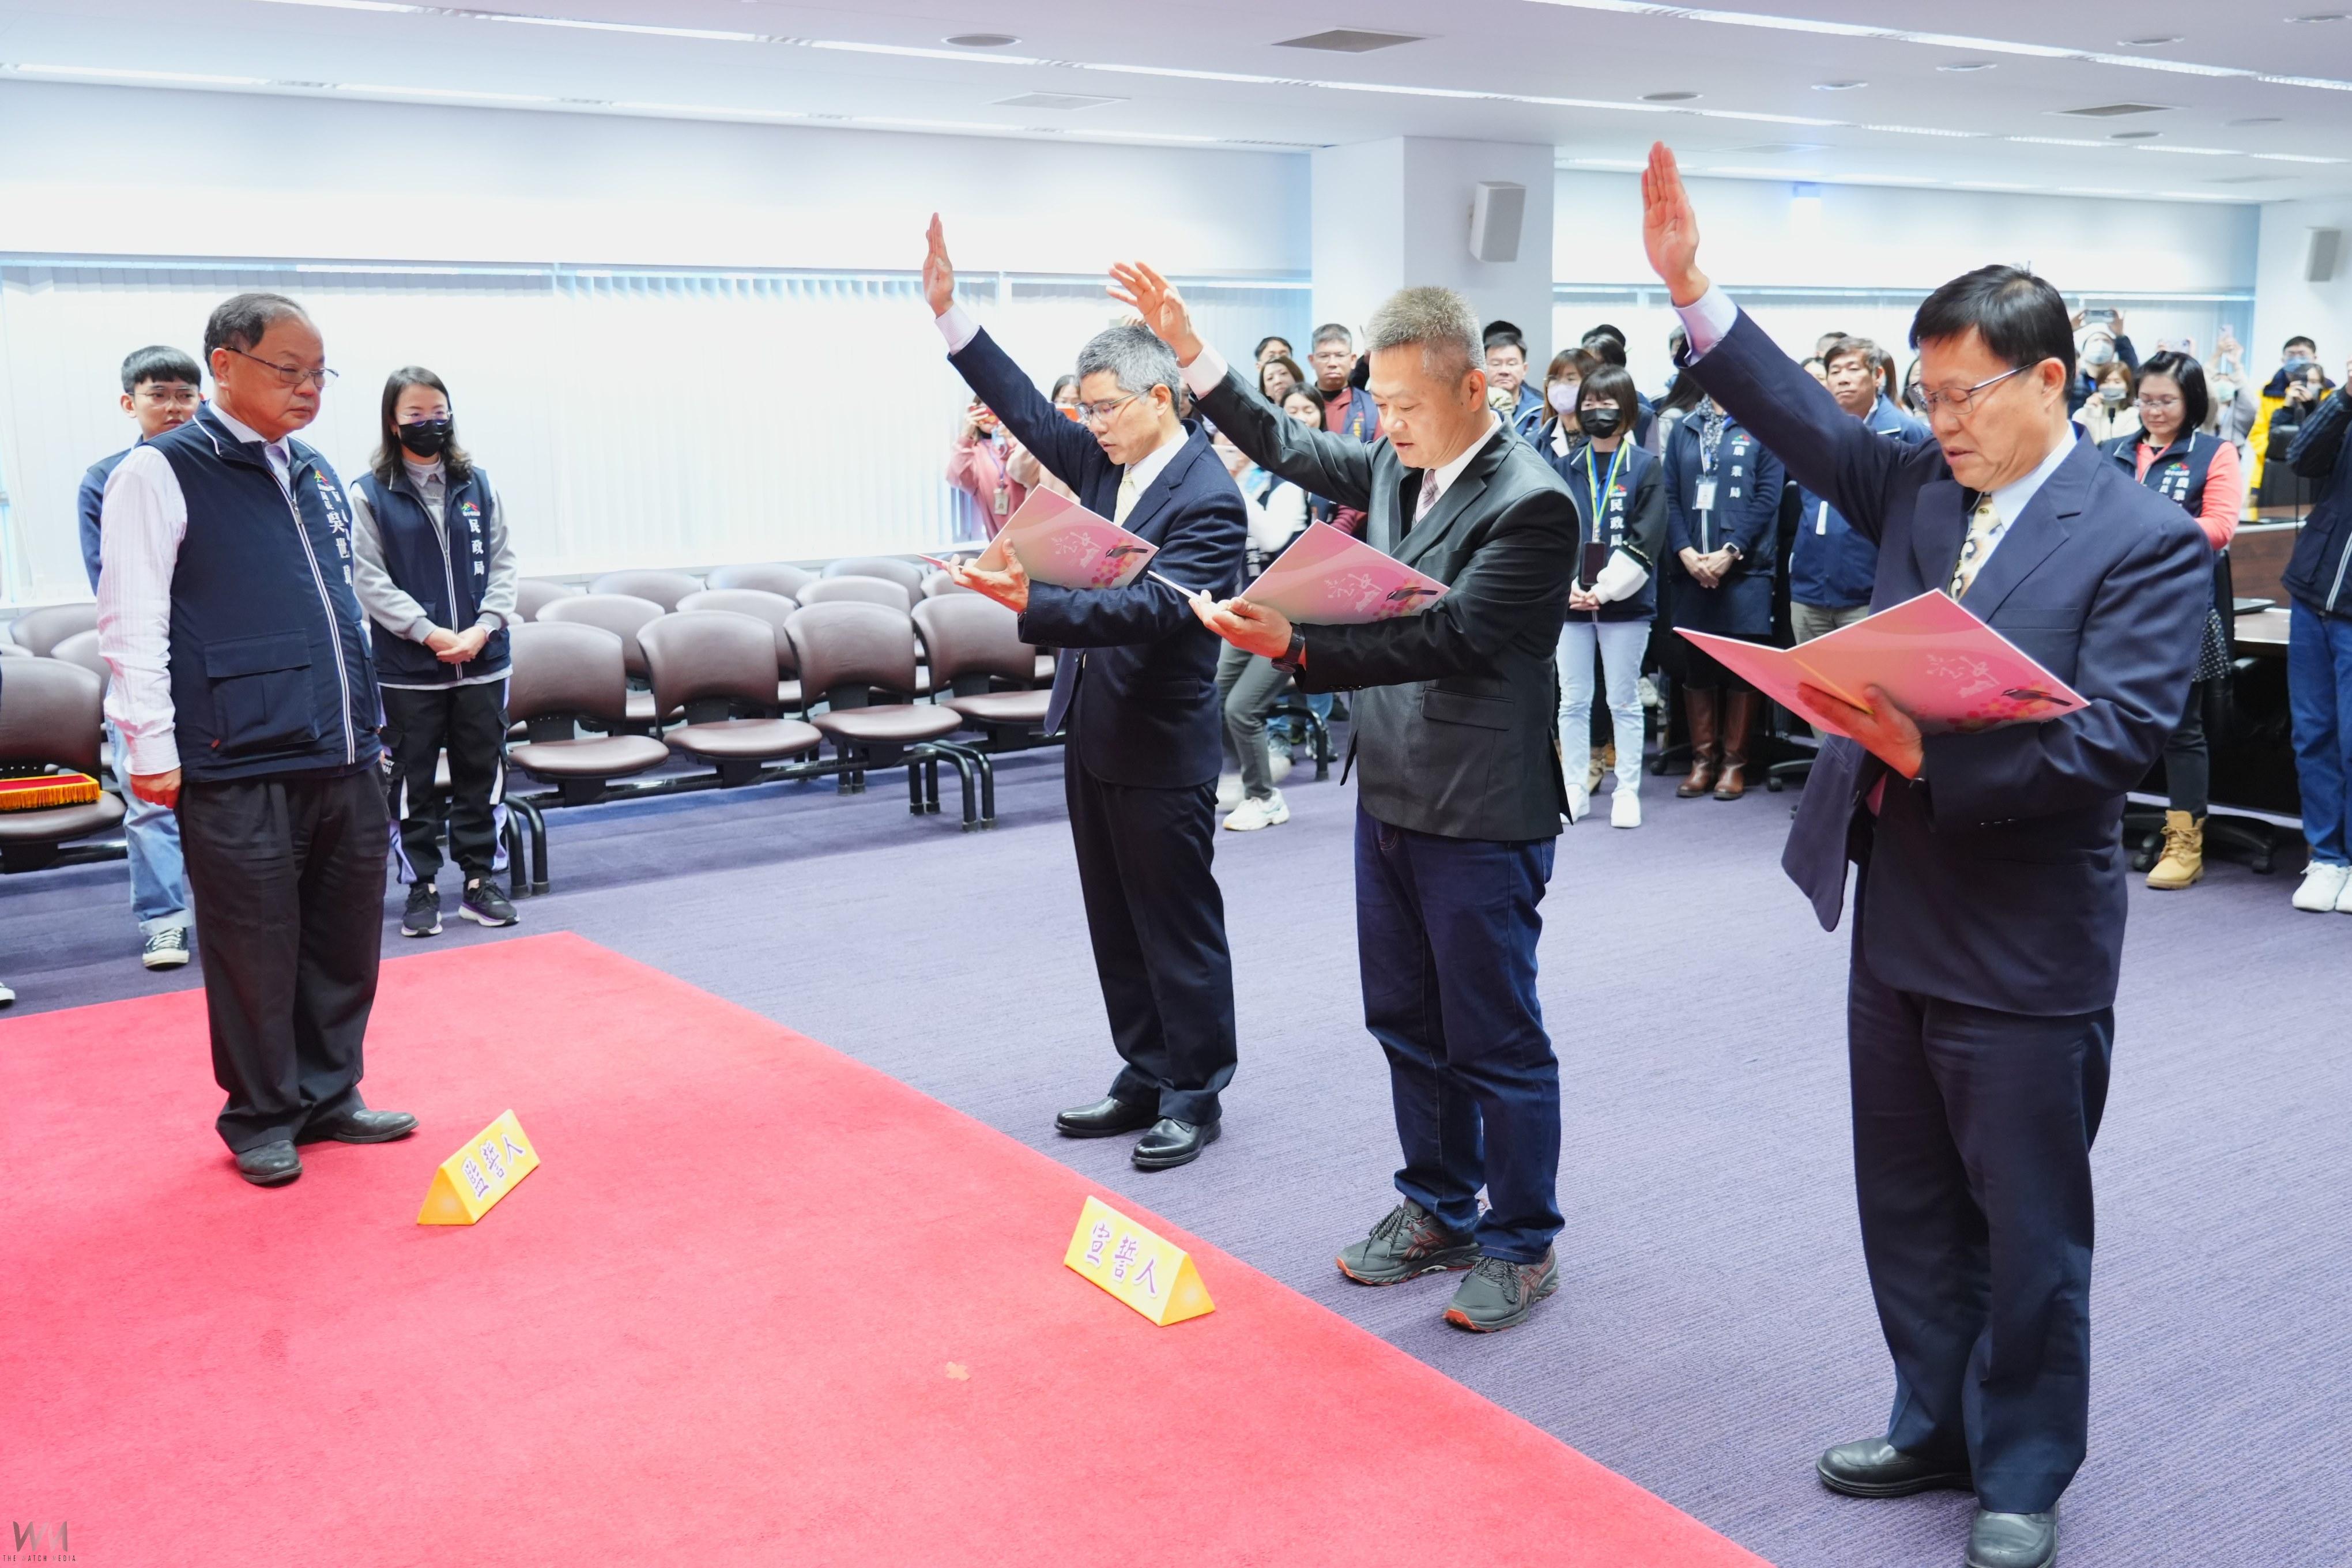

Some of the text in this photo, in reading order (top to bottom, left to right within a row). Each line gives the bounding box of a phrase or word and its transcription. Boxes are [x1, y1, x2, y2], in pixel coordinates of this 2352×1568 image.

[469, 519, 485, 576] 民政局
[1610, 498, 1624, 547] 民政局
[1087, 1223, 1156, 1294] 宣誓人
